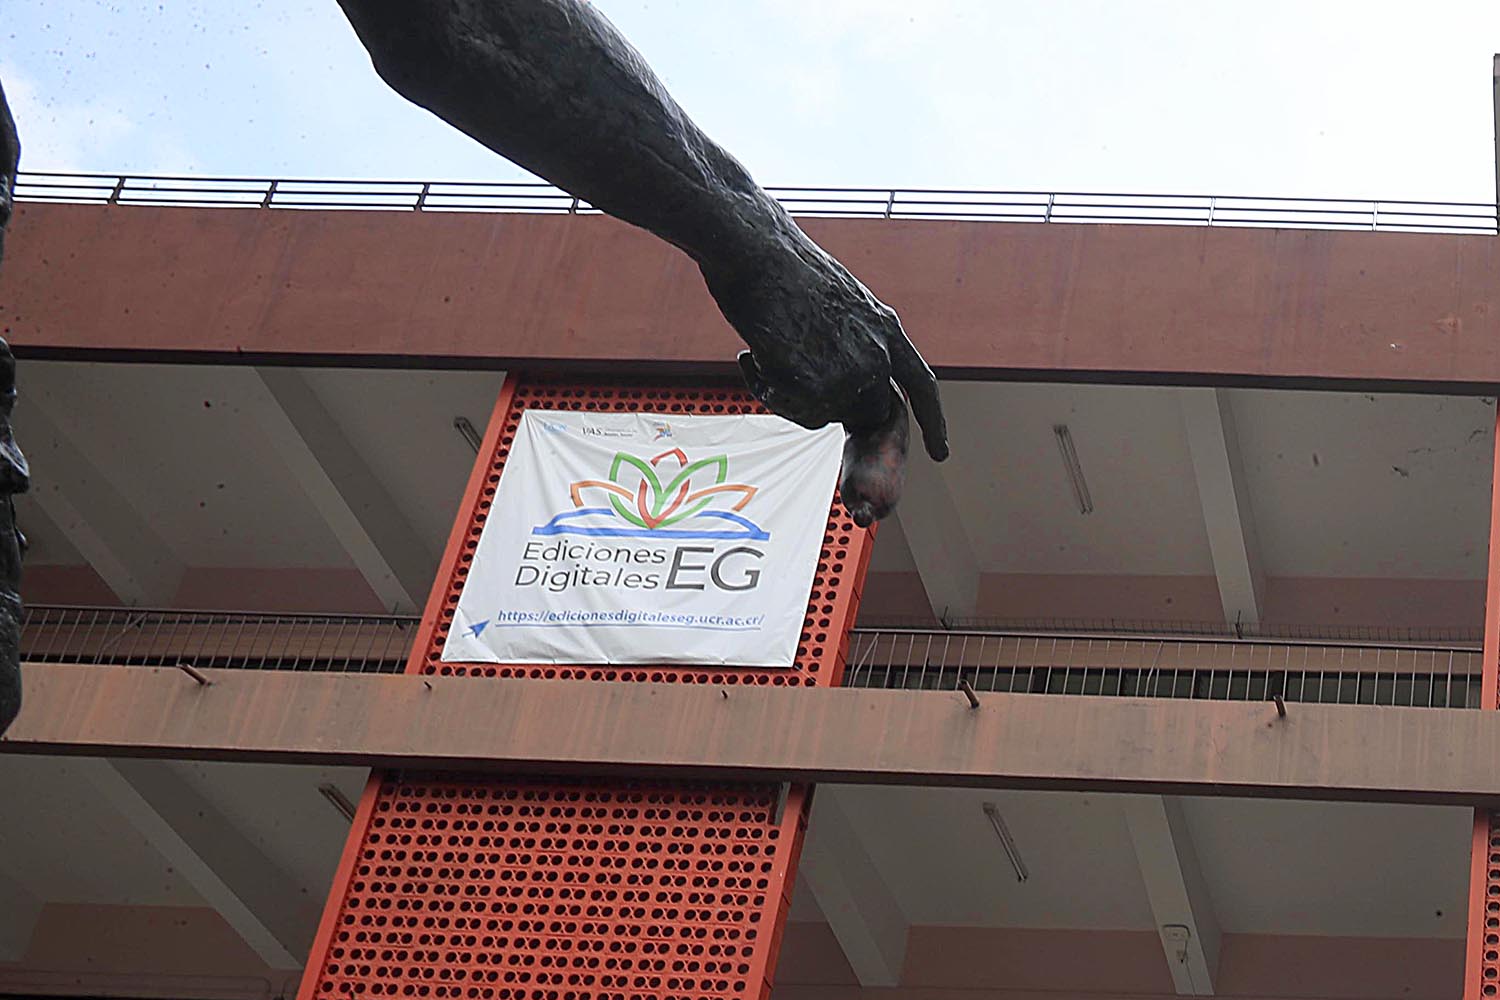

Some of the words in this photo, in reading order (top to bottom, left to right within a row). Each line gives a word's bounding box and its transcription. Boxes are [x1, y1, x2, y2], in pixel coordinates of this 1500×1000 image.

[522, 539, 666, 564] Ediciones
[514, 564, 660, 593] Digitales
[665, 546, 765, 591] EG
[497, 609, 765, 627] https://edicionesdigitaleseg.ucr.ac.cr/
